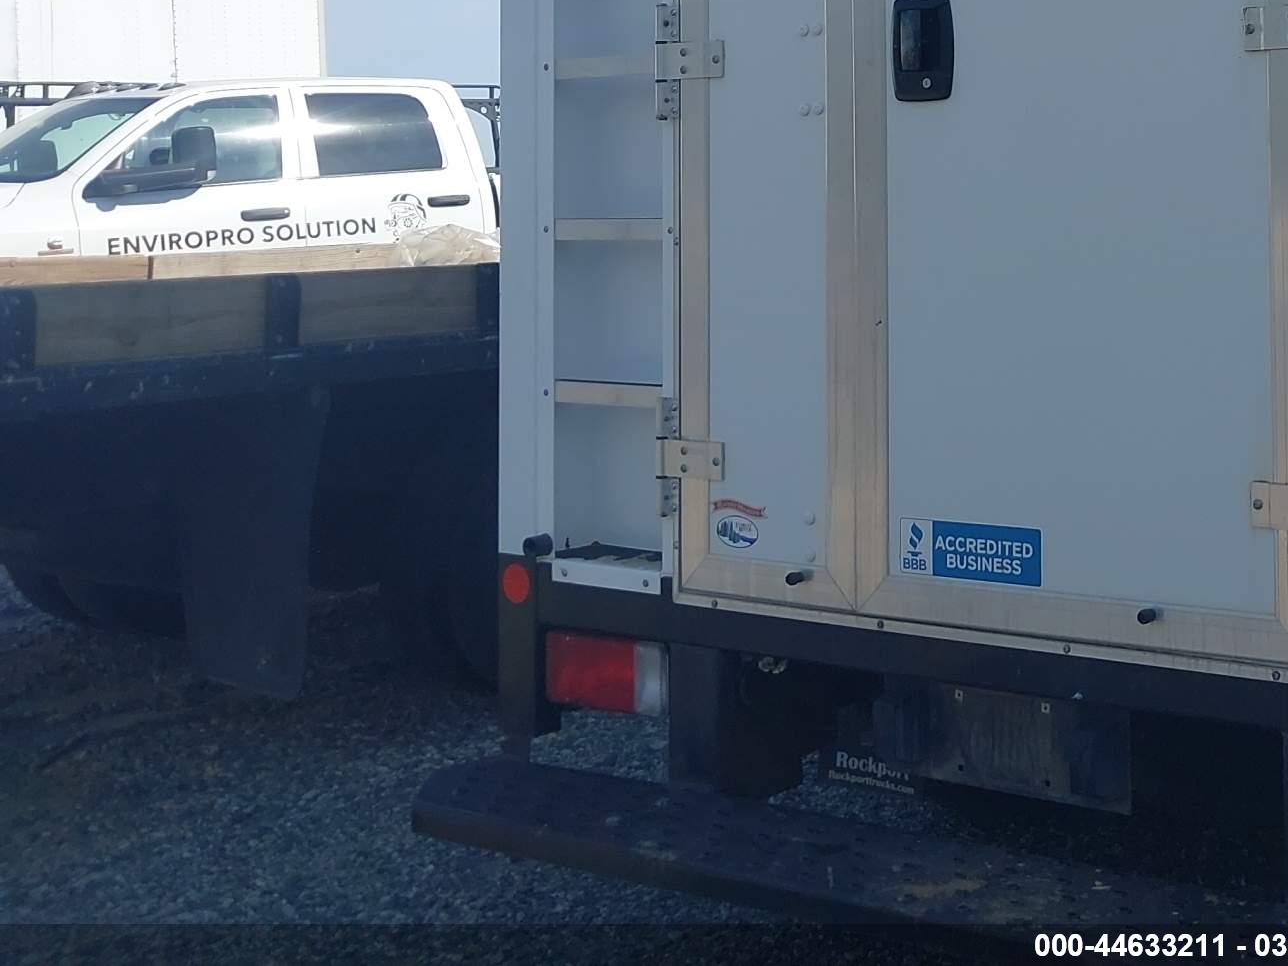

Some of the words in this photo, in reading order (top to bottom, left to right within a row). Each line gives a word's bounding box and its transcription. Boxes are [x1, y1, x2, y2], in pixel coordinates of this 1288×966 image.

[107, 226, 255, 256] ENVIROPRO
[262, 217, 377, 243] SOLUTION
[935, 535, 1034, 558] ACCREDITED
[903, 557, 927, 571] BBB
[946, 553, 1022, 575] BUSINESS
